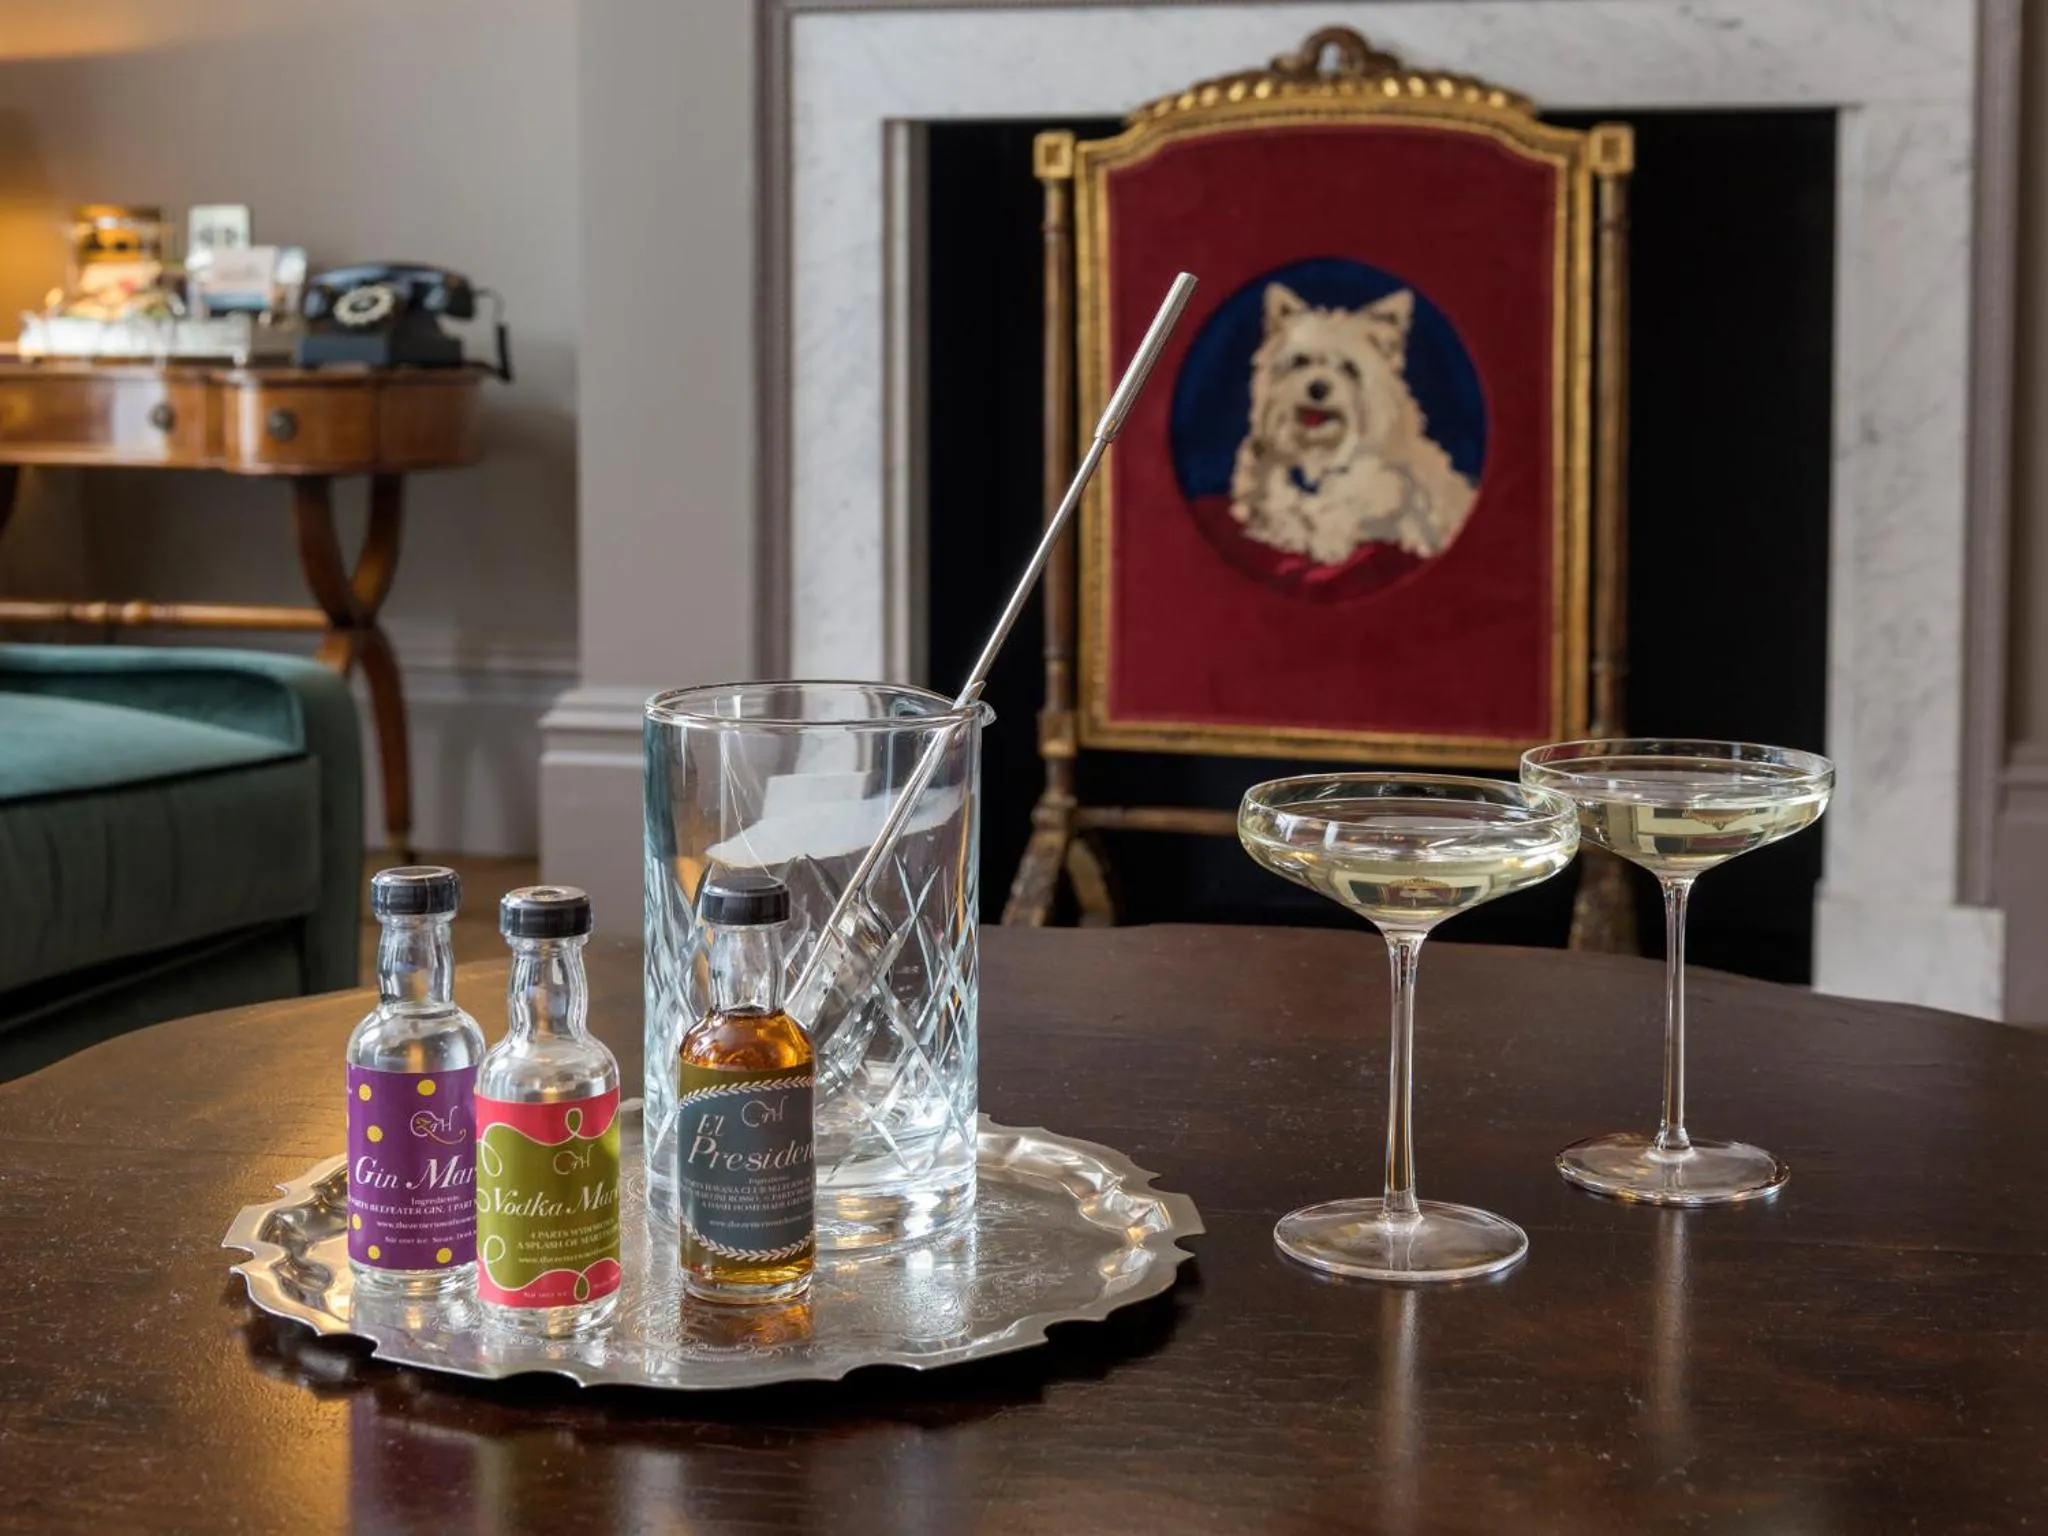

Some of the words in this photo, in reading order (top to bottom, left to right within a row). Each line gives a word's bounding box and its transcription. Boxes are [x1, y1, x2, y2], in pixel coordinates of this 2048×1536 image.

[697, 1112, 725, 1137] El
[355, 1156, 399, 1188] Gin
[493, 1187, 562, 1217] Vodka
